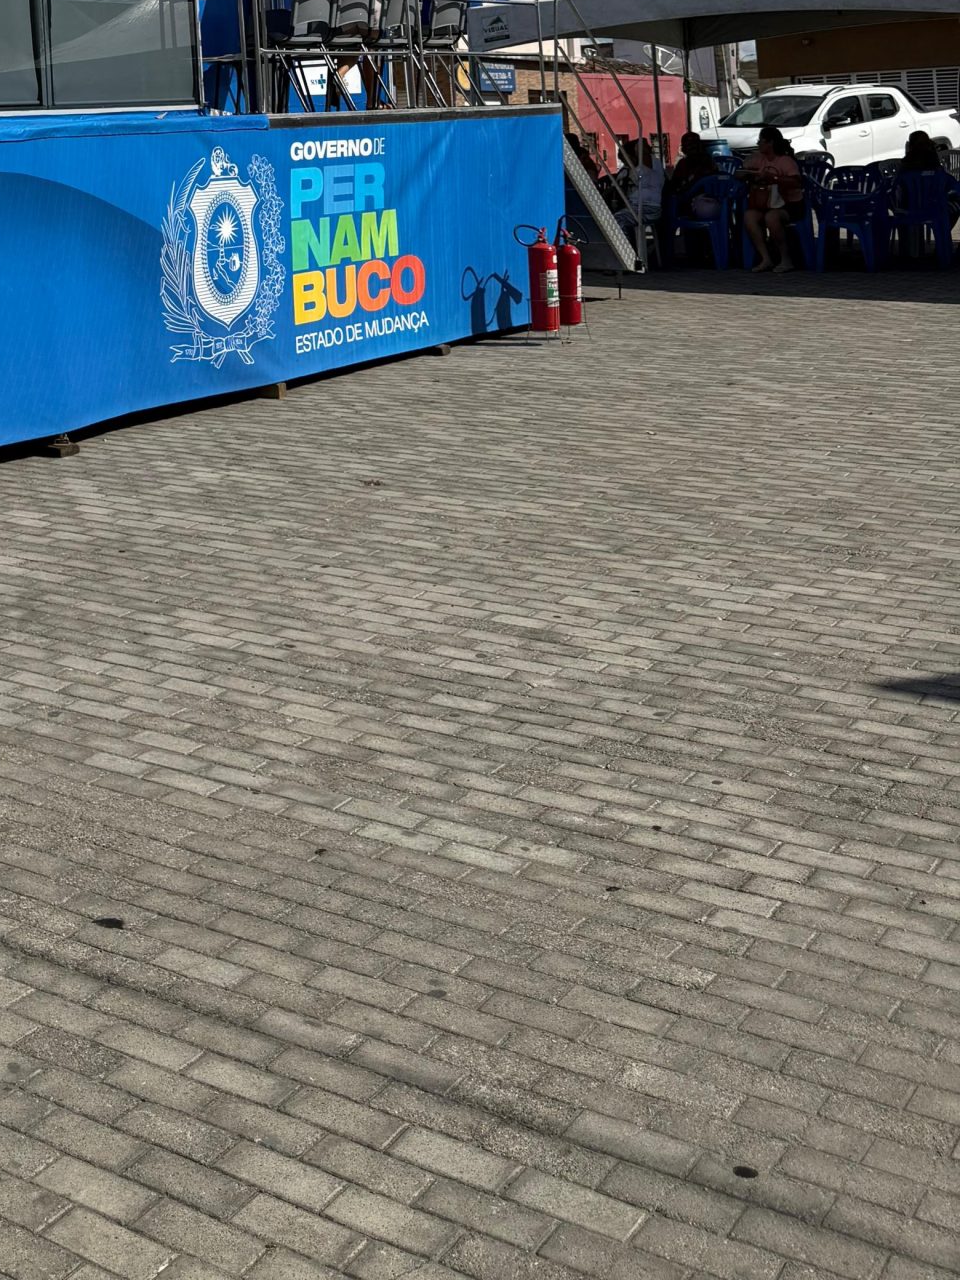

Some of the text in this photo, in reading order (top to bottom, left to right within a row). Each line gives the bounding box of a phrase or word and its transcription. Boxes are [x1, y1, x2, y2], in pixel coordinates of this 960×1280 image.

[290, 137, 385, 161] GOVERNO DE
[290, 162, 385, 219] PER
[291, 209, 399, 271] NAM
[293, 254, 426, 326] BUCO
[295, 310, 429, 354] ESTADO DE MUDANÇA
